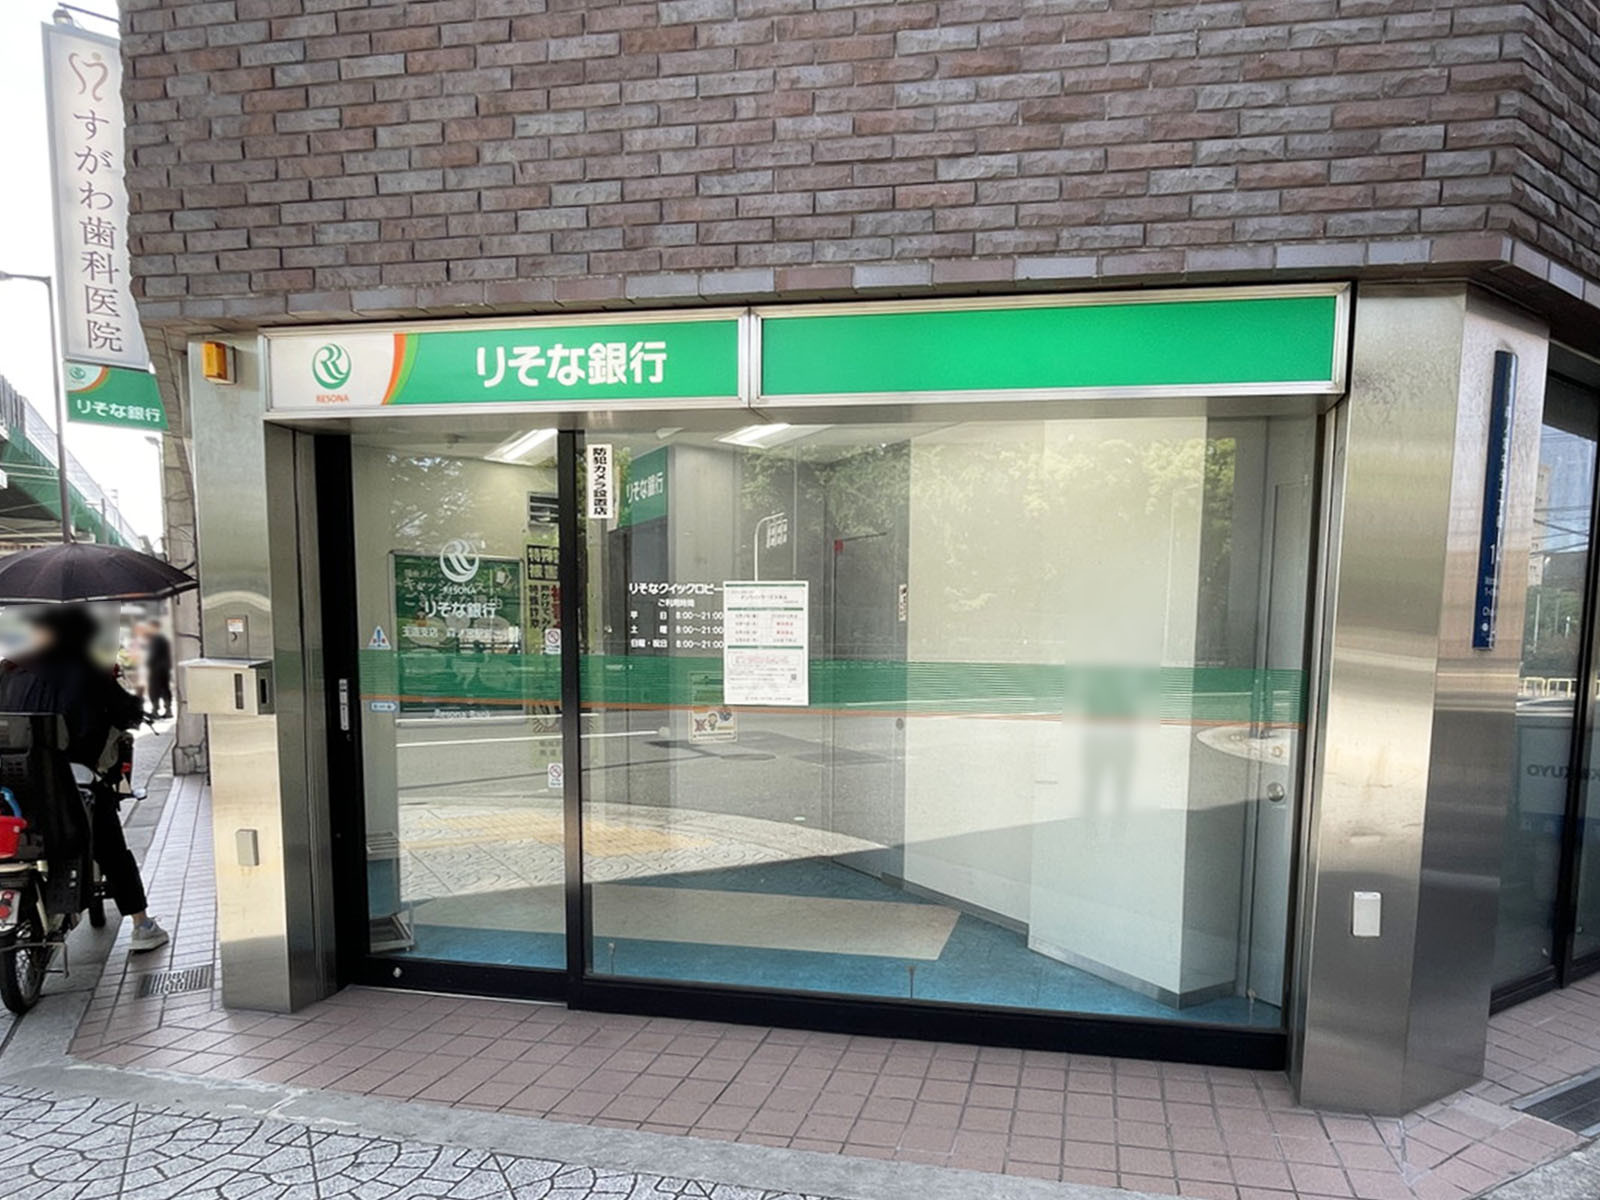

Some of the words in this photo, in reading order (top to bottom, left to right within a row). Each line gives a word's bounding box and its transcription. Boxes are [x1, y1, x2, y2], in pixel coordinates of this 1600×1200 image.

[73, 108, 123, 353] すがわ歯科医院
[476, 341, 667, 388] りそな銀行
[77, 399, 160, 422] りそな銀行
[593, 447, 607, 515] 防犯カメラ設置店
[626, 472, 664, 504] りそな銀行
[629, 583, 723, 595] りそなクイックロビー
[424, 600, 497, 618] りそな銀行
